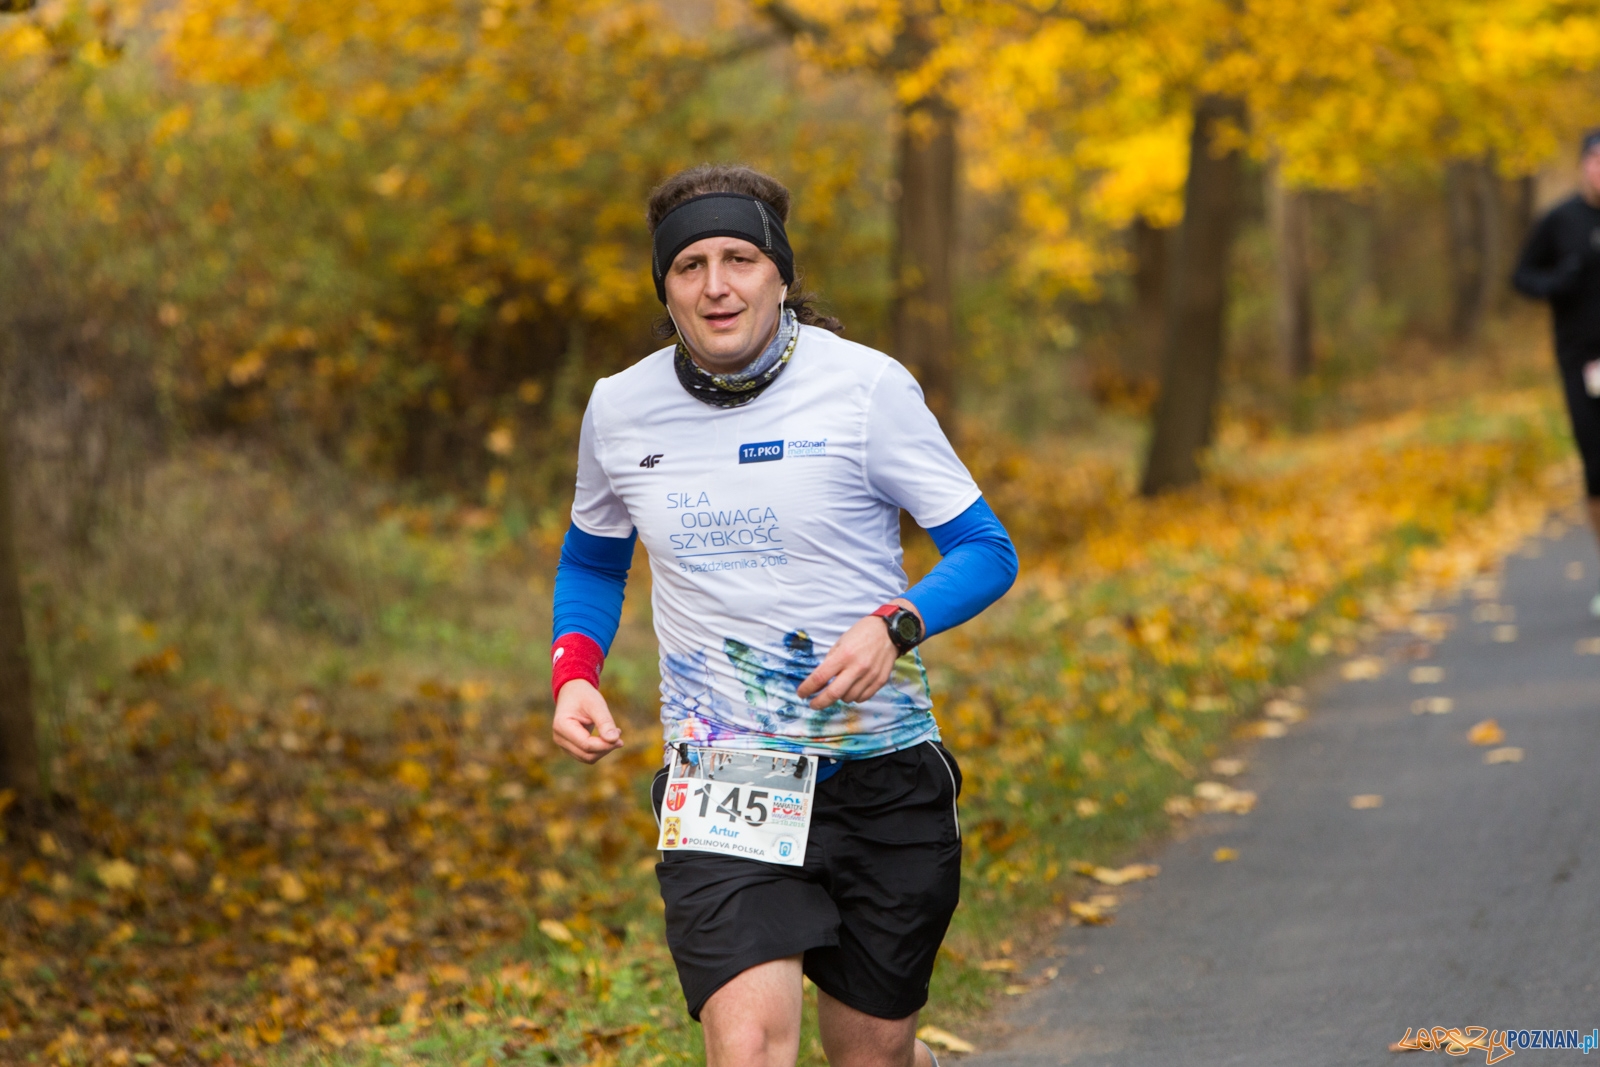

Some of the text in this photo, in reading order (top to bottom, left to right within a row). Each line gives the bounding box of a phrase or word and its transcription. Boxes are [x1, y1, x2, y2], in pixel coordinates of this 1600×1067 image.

[743, 445, 781, 458] 17. PKO
[787, 446, 826, 455] maraton
[639, 454, 664, 468] 4F
[667, 491, 711, 509] SIŁA
[681, 507, 778, 529] ODWAGA
[669, 524, 783, 550] SZYBKOŚĆ
[679, 555, 788, 574] 9 października 2016
[694, 783, 769, 827] 145
[709, 825, 740, 839] Artur
[688, 837, 730, 850] POLINOVA
[732, 843, 766, 857] POLSKA
